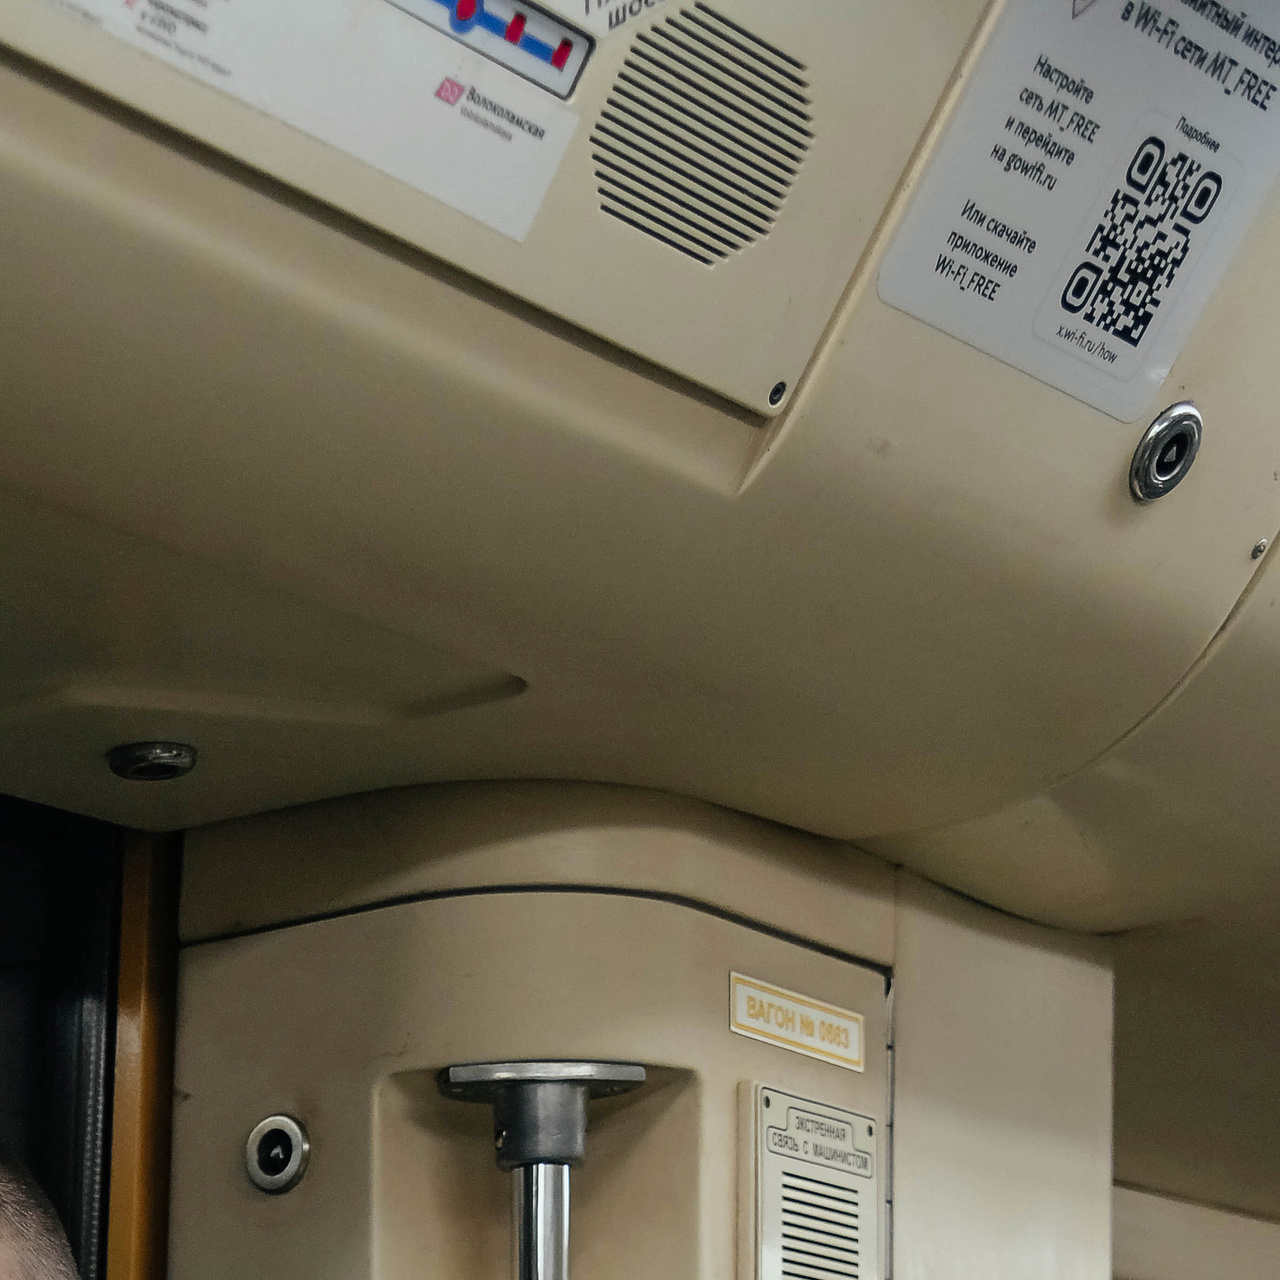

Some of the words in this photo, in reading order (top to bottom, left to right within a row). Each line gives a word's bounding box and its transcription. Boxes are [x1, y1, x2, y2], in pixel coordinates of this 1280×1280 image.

[1033, 54, 1094, 104] Настройте
[1120, 1, 1135, 21] в
[1134, 1, 1180, 49] Wi-Fi
[1173, 36, 1209, 70] сети
[1205, 50, 1277, 111] MT_FREE
[1019, 87, 1044, 113] сеть
[1044, 99, 1101, 144] MT_FREE
[1175, 115, 1220, 154] Подробнее
[1004, 115, 1015, 132] и
[1014, 121, 1075, 166] перейдите
[990, 143, 1007, 163] на
[1003, 152, 1057, 191] gowifi.ru
[960, 198, 987, 228] Или
[986, 217, 1036, 254] скачайте
[934, 253, 1001, 301] Wi-Fi_FREE
[946, 230, 1018, 278] приложение
[1055, 324, 1118, 364] x.wi-fi.ru/how
[746, 995, 796, 1032] ВАГОН
[771, 1131, 799, 1153] СВЯЗЬ
[812, 1142, 868, 1170] МАШИНИСТОМ
[795, 1115, 846, 1141] ЭКСТРЕННАЯ
